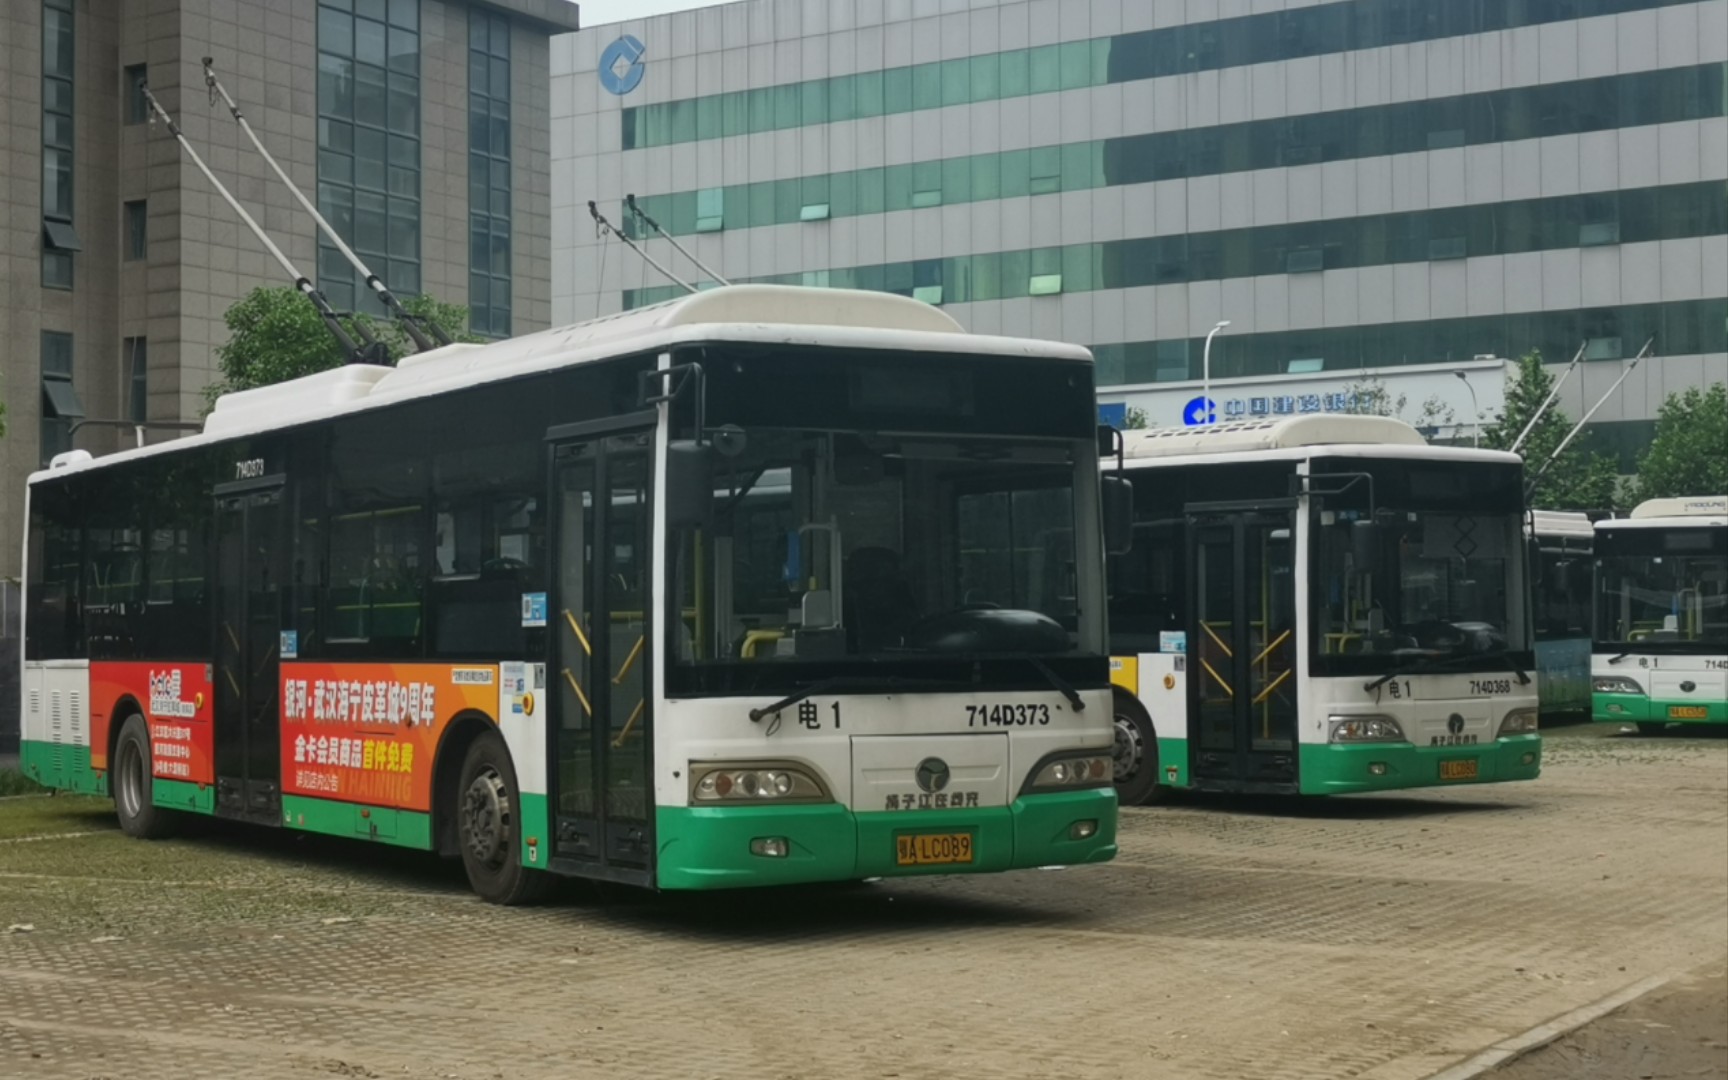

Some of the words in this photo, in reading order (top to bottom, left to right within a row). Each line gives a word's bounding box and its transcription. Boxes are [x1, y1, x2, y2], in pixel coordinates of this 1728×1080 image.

[1224, 392, 1372, 415] 中国建设银行
[1389, 679, 1401, 699] 电
[1405, 680, 1411, 697] 1
[1469, 679, 1511, 695] 714D368
[798, 700, 821, 730] 电
[831, 701, 840, 729] 1
[966, 704, 1050, 727] 714D373
[294, 734, 414, 774] 金卡会员商品首件免费
